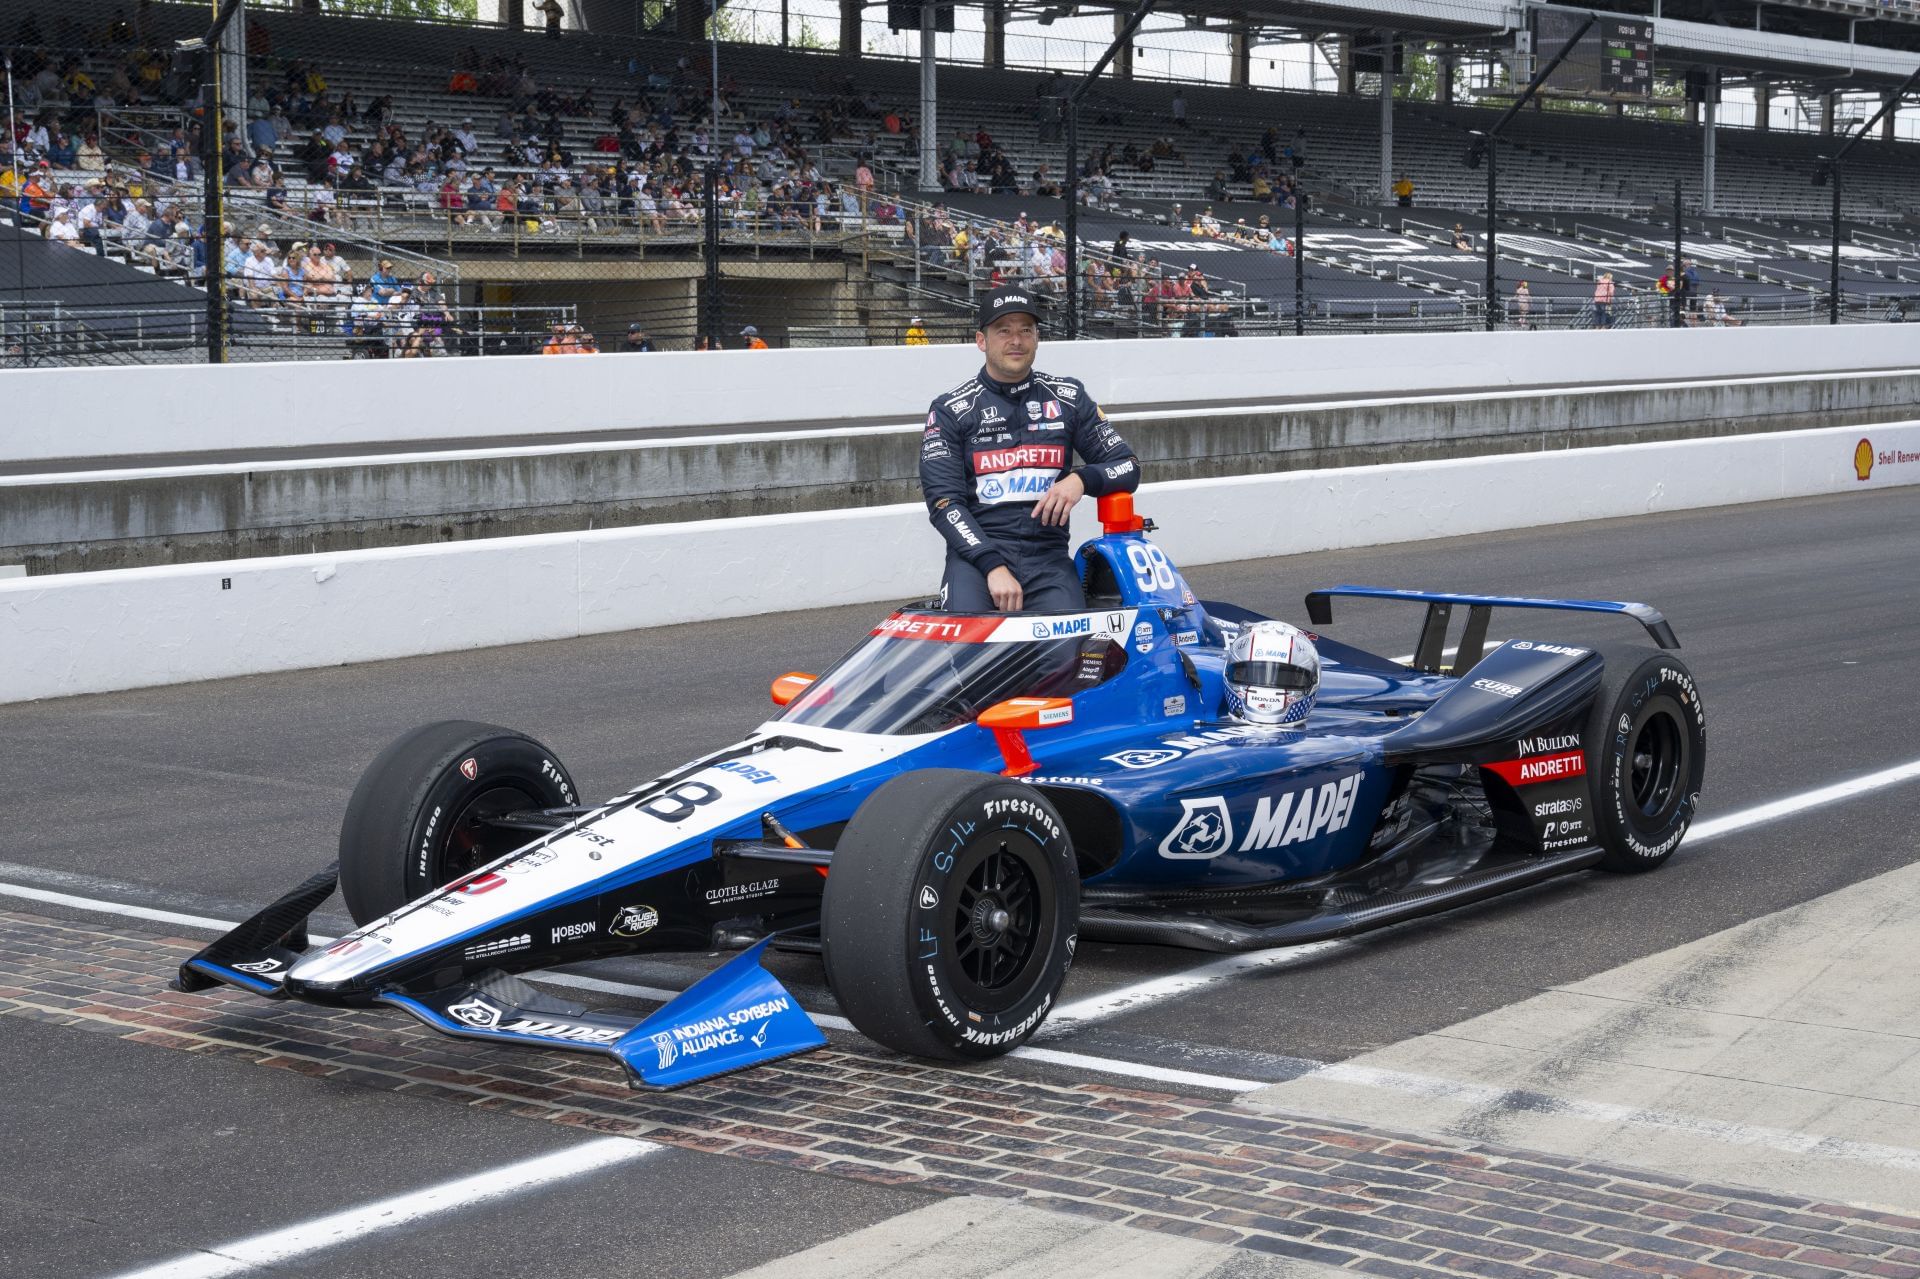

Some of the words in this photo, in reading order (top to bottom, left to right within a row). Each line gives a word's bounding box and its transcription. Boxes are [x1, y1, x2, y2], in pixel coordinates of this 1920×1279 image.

[1004, 296, 1028, 305] MAPEI
[1056, 386, 1077, 398] OMP
[951, 400, 969, 414] OMP
[980, 448, 1062, 470] ANDRETTI
[1878, 450, 1896, 465] Shell
[1008, 476, 1056, 493] MAPE
[953, 521, 982, 547] MAPEI
[1126, 544, 1176, 592] 98
[874, 617, 963, 637] NDRETTI
[1052, 617, 1091, 635] MAPEI
[1265, 649, 1288, 659] MAPEI
[1533, 643, 1584, 657] MAPEI
[1474, 679, 1523, 695] CURB
[1660, 667, 1704, 725] Firestone
[1043, 709, 1069, 720] SIEMENS
[1517, 739, 1535, 760] JM
[1536, 734, 1580, 752] BULLION
[711, 761, 778, 784] APEI
[1520, 756, 1582, 779] ANDRETTI
[541, 759, 573, 804] Fires
[1010, 776, 1103, 785] estone
[1238, 772, 1361, 852] MAPEI
[1534, 797, 1582, 817] stratasys
[984, 798, 1060, 839] Firestone
[1569, 821, 1582, 831] NTT
[934, 818, 977, 874] S-14
[1543, 835, 1588, 850] Firestone
[1625, 820, 1685, 857] FIREHAWK
[705, 885, 739, 900] CLOTH
[740, 884, 749, 893] &
[749, 878, 780, 893] GLAZE
[722, 895, 745, 903] PAINTING
[624, 911, 657, 925] ROUGH
[630, 918, 658, 931] RIDER
[551, 921, 596, 944] HOBSON
[507, 945, 531, 953] COMPANY
[927, 964, 941, 994] 500
[672, 1016, 730, 1041] INDIANA
[728, 997, 790, 1026] SOYBEAN
[937, 995, 961, 1028] INDY
[961, 993, 1051, 1045] FIREHAWK
[501, 1020, 626, 1042] MAPEI
[682, 1028, 739, 1057] ALLIANCE
